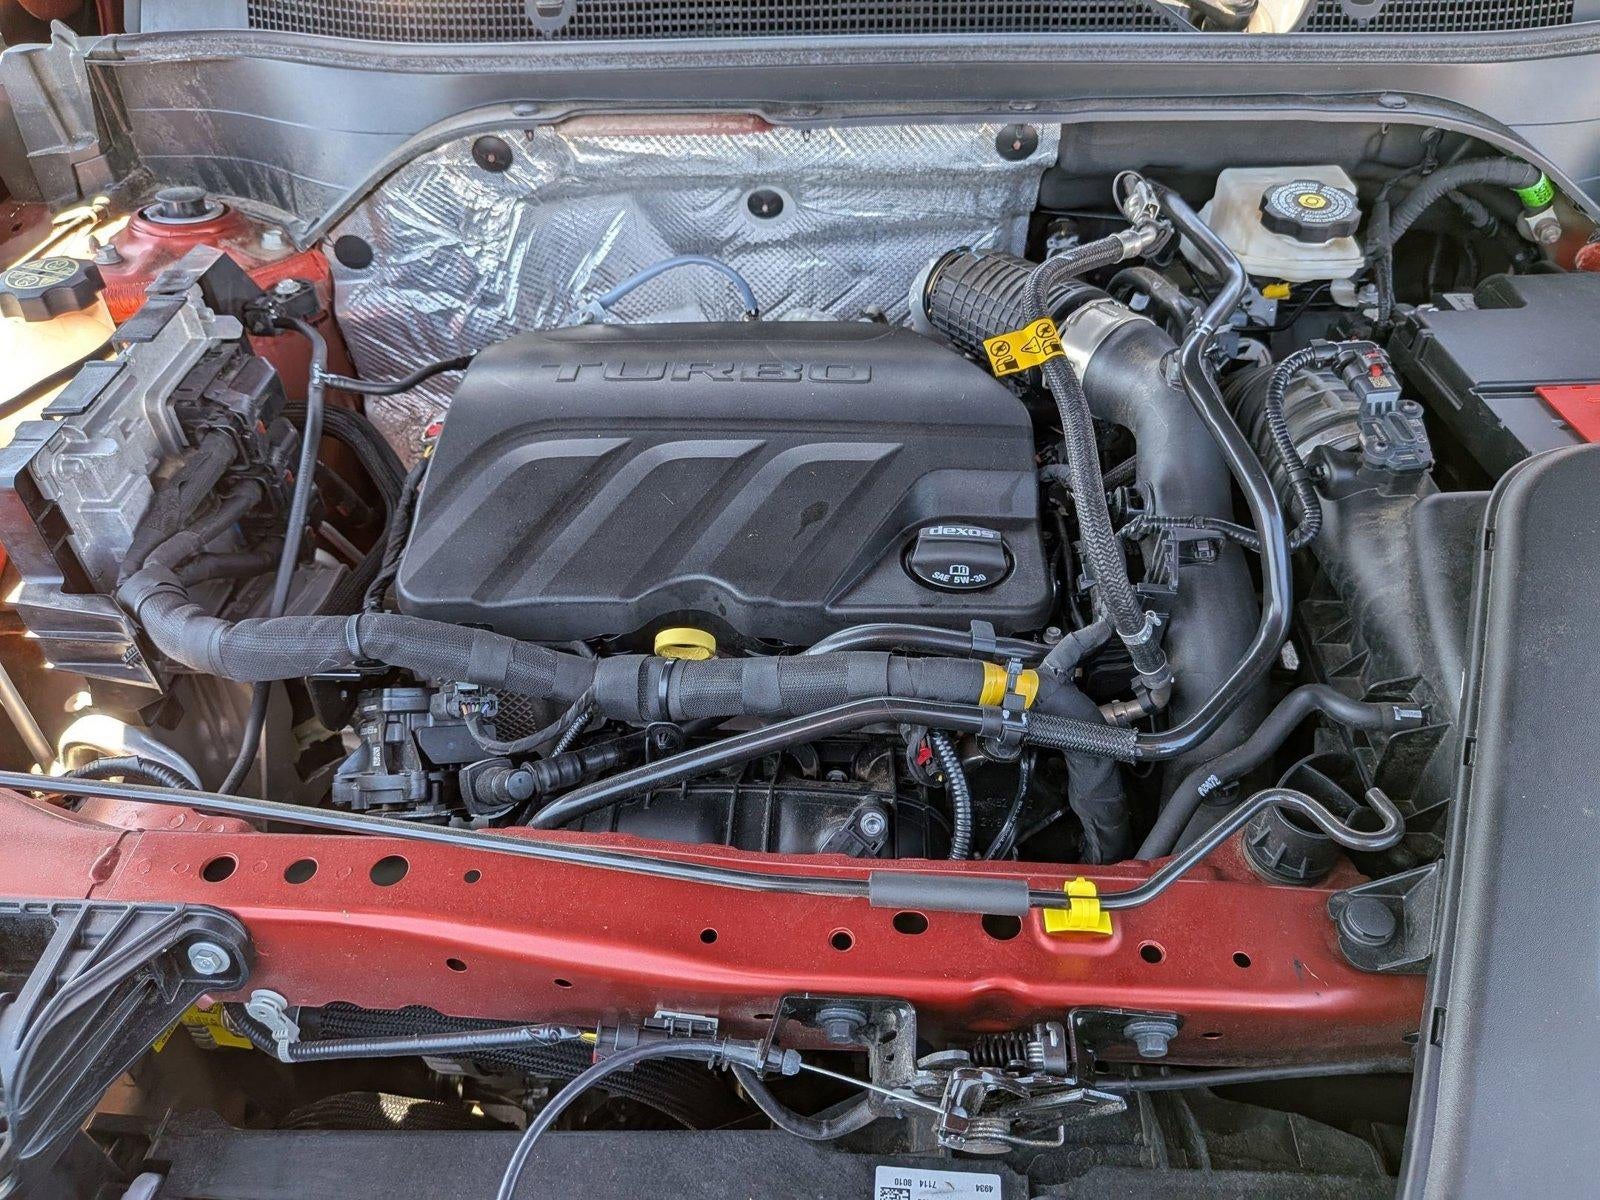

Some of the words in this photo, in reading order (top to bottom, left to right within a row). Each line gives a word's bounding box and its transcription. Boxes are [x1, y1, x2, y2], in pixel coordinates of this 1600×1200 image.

[541, 361, 873, 383] TURBO
[929, 525, 994, 538] dexos
[932, 571, 951, 582] SAE
[953, 573, 987, 584] 5W-30
[919, 1180, 937, 1189] 7114
[975, 1184, 994, 1193] 4934
